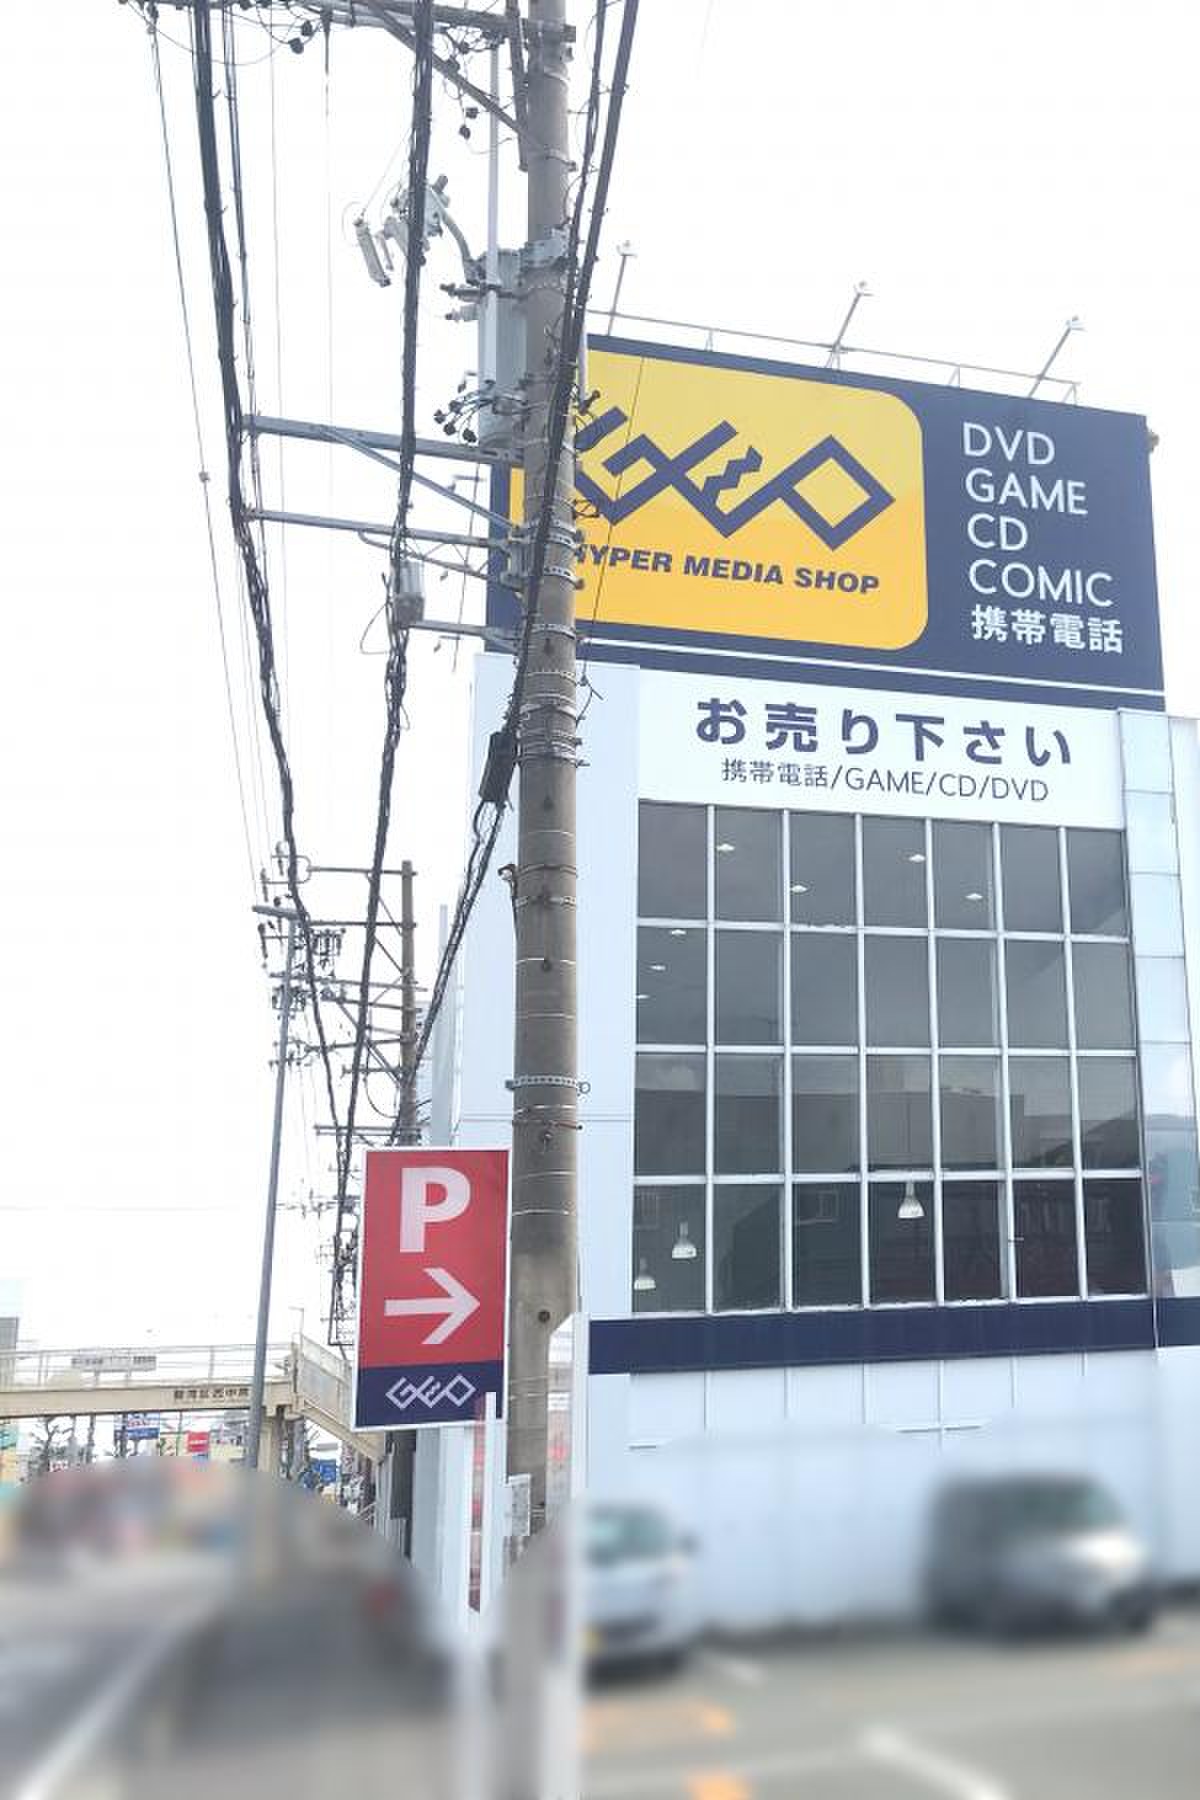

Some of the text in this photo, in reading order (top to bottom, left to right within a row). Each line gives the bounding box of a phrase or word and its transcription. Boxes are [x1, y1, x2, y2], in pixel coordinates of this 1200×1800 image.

[963, 421, 1056, 465] DVD
[964, 470, 1088, 516] GAME
[966, 513, 1029, 552] CD
[683, 555, 784, 585] MEDIA
[794, 567, 880, 595] SHOP
[968, 559, 1114, 608] COMIC
[970, 604, 1123, 655] 携帯電話
[696, 697, 1072, 767] お売り下さい
[399, 1166, 471, 1253] P
[385, 1374, 477, 1410] GEO
